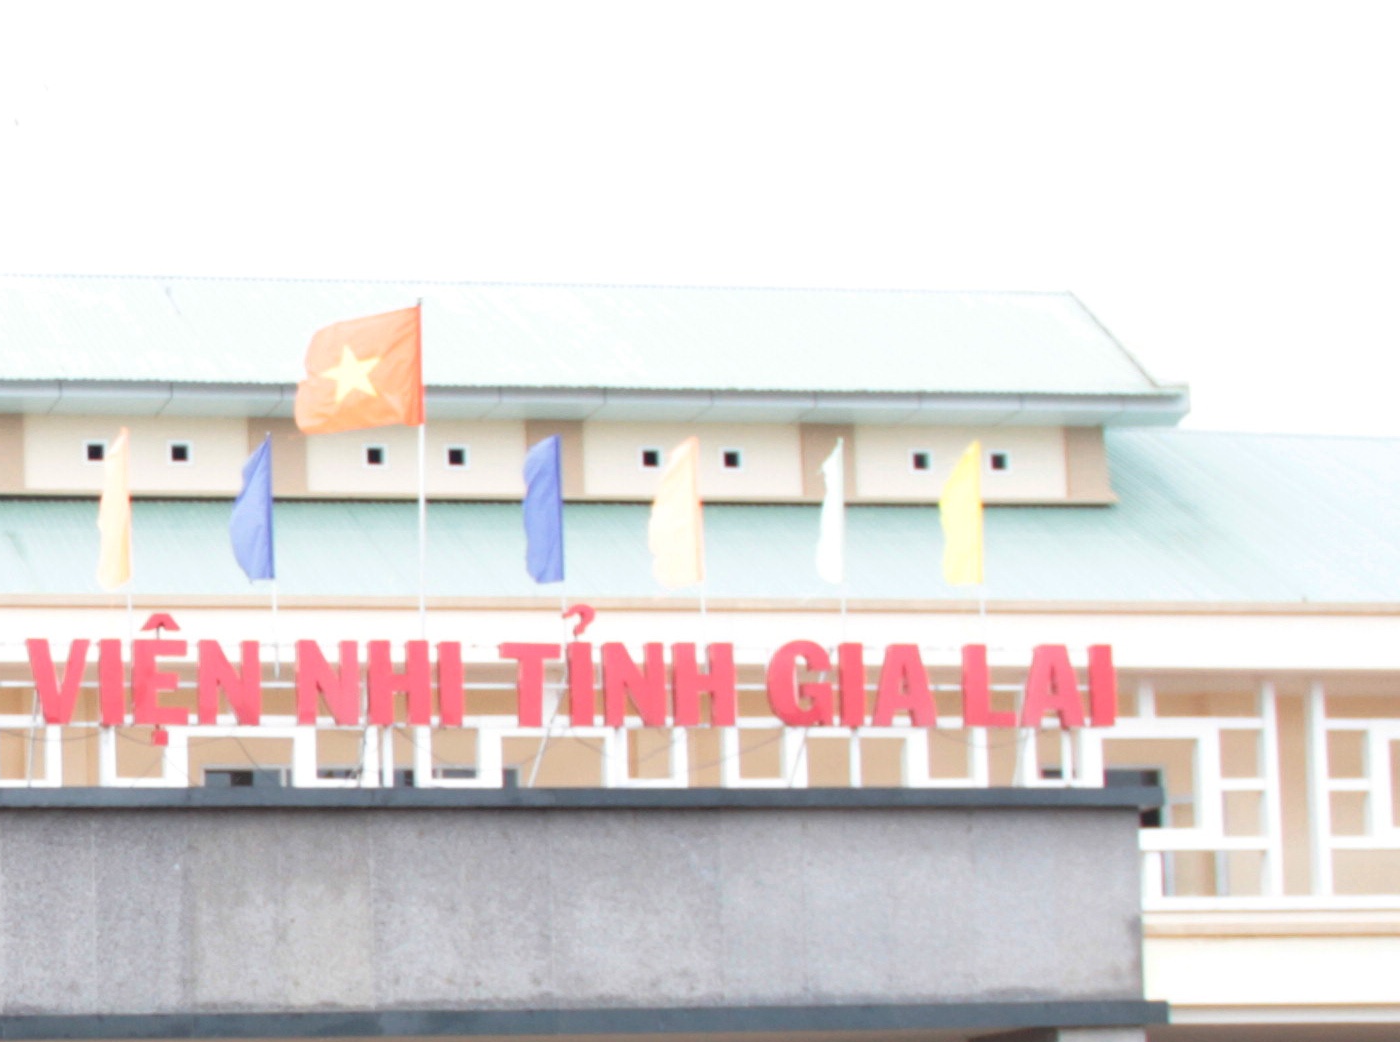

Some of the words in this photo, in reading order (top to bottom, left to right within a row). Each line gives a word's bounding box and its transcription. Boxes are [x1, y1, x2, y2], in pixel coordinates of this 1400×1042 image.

[25, 612, 261, 747] VIỆN
[295, 640, 465, 727] NHI
[499, 603, 737, 727] TỈNH
[767, 639, 938, 728] GIA
[961, 643, 1117, 728] LAI
